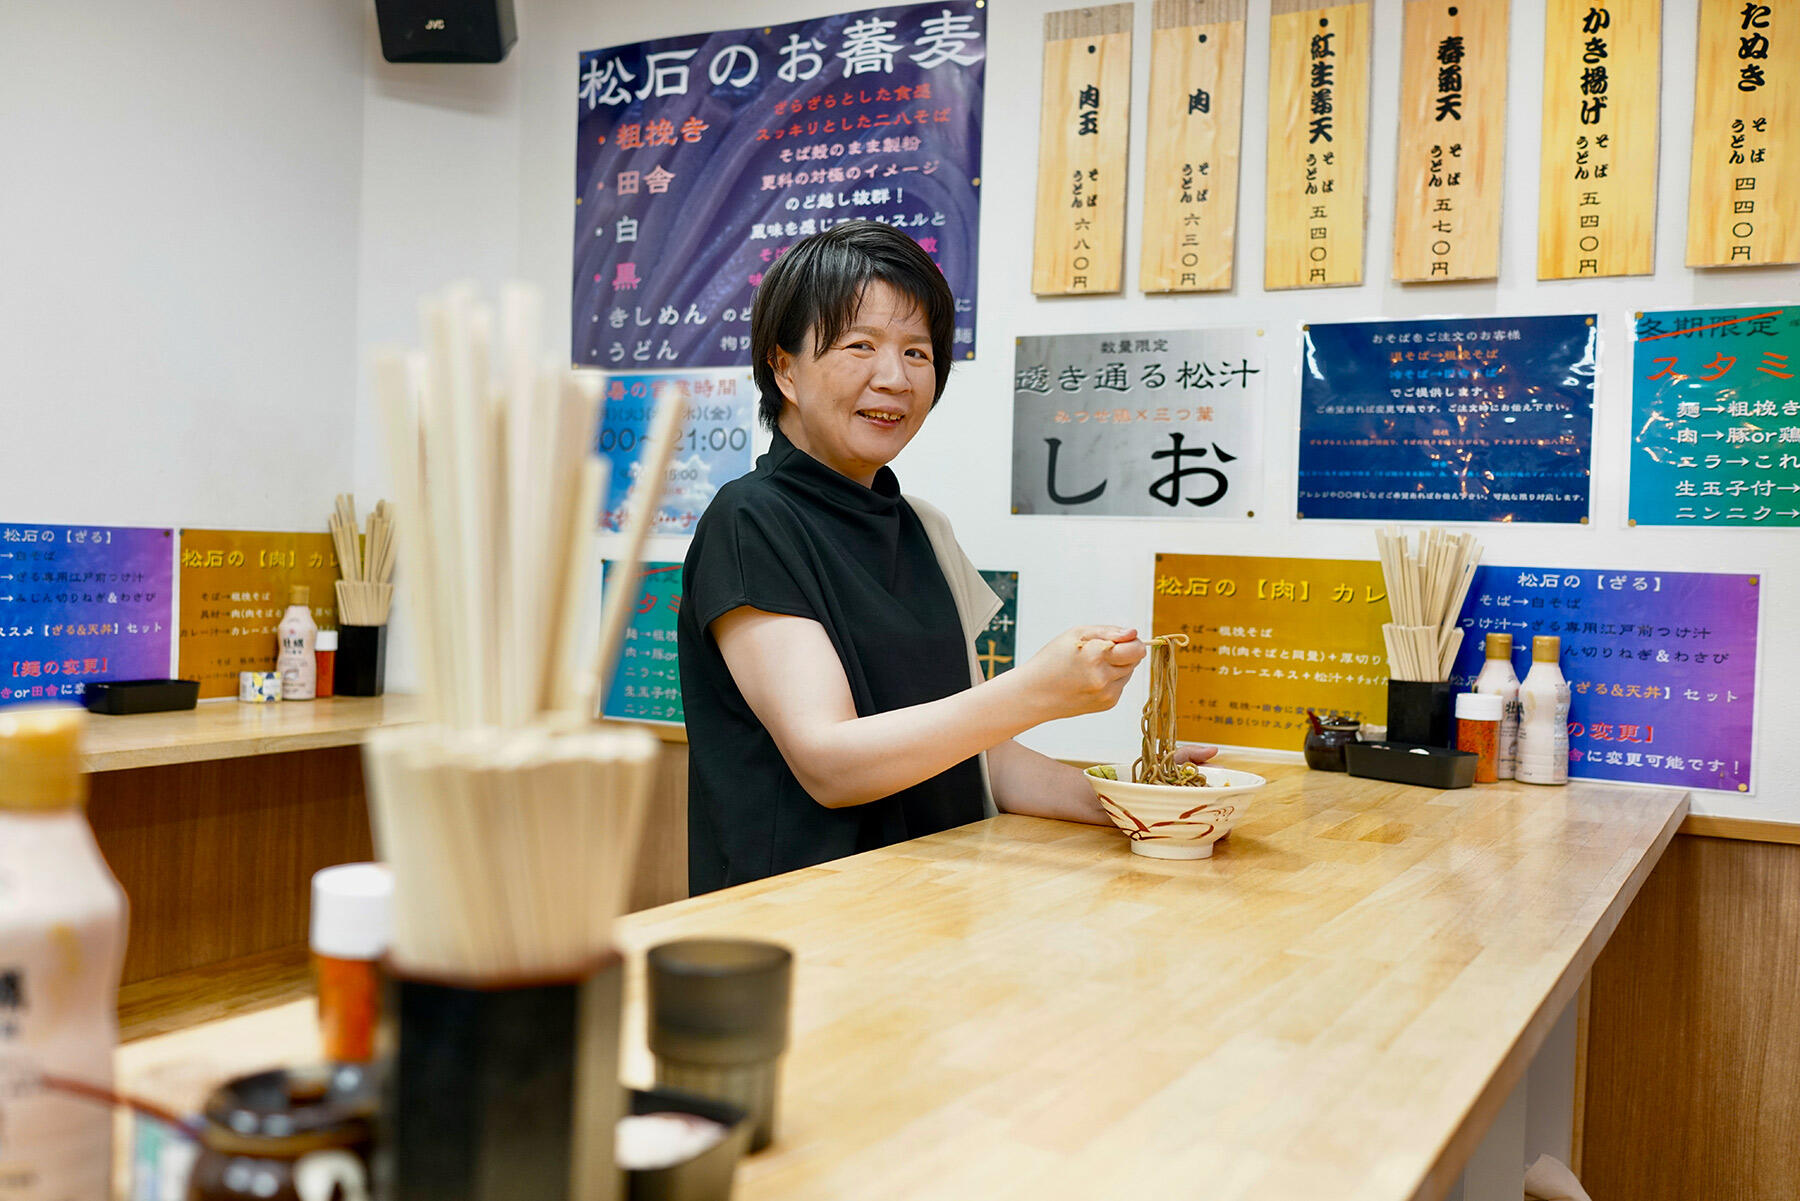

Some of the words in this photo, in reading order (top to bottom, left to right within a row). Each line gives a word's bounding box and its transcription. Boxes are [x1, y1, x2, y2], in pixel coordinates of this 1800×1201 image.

[424, 18, 446, 31] JVC
[579, 9, 986, 110] 松石のお蕎麦
[1579, 7, 1611, 126] かき揚げ
[1737, 2, 1772, 93] たぬき
[774, 83, 932, 117] ざらざらとした食感
[1077, 84, 1100, 137] 肉玉
[1188, 88, 1210, 116] 肉
[615, 116, 711, 151] 粗挽き
[1728, 118, 1746, 165] うどん
[1750, 117, 1768, 164] そば
[1304, 153, 1318, 196] うどん
[1321, 151, 1335, 194] そば
[1428, 144, 1444, 189] うどん
[1447, 143, 1463, 187] そば
[1574, 135, 1590, 182] うどん
[1593, 133, 1610, 180] そば
[616, 164, 677, 197] 田舎
[1071, 170, 1084, 209] うどん
[1086, 168, 1099, 208] そば
[1180, 163, 1194, 204] うどん
[1196, 162, 1210, 203] そば
[615, 215, 640, 243] 白
[1431, 198, 1453, 276] 五七〇円
[1578, 191, 1601, 275] 五四〇円
[1731, 177, 1757, 262] 四四〇円
[1072, 218, 1091, 289] 六八〇円
[1180, 213, 1201, 286] 六三〇円
[1309, 205, 1328, 283] 五四〇円
[611, 262, 642, 291] 黒
[608, 302, 708, 329] きしめん
[608, 338, 680, 362] うどん
[1100, 338, 1169, 354] 数量限定
[1372, 329, 1522, 344] おそばをご注文のお客様
[1014, 358, 1261, 395] 透き通る松汁
[1646, 351, 1795, 382] スタミ
[1676, 427, 1699, 445] 肉
[1043, 431, 1238, 508] しお
[1674, 479, 1777, 498] 生玉子付
[1675, 506, 1773, 521] ニンニク
[3, 528, 112, 545] 松石の【ざる】
[1479, 594, 1512, 607] そば
[1517, 572, 1662, 593] 松石の【ざる】
[624, 592, 682, 615] タミ
[1462, 617, 1512, 630] つけ汁
[1218, 645, 1391, 666] 肉(肉そばと同量)+厚切り
